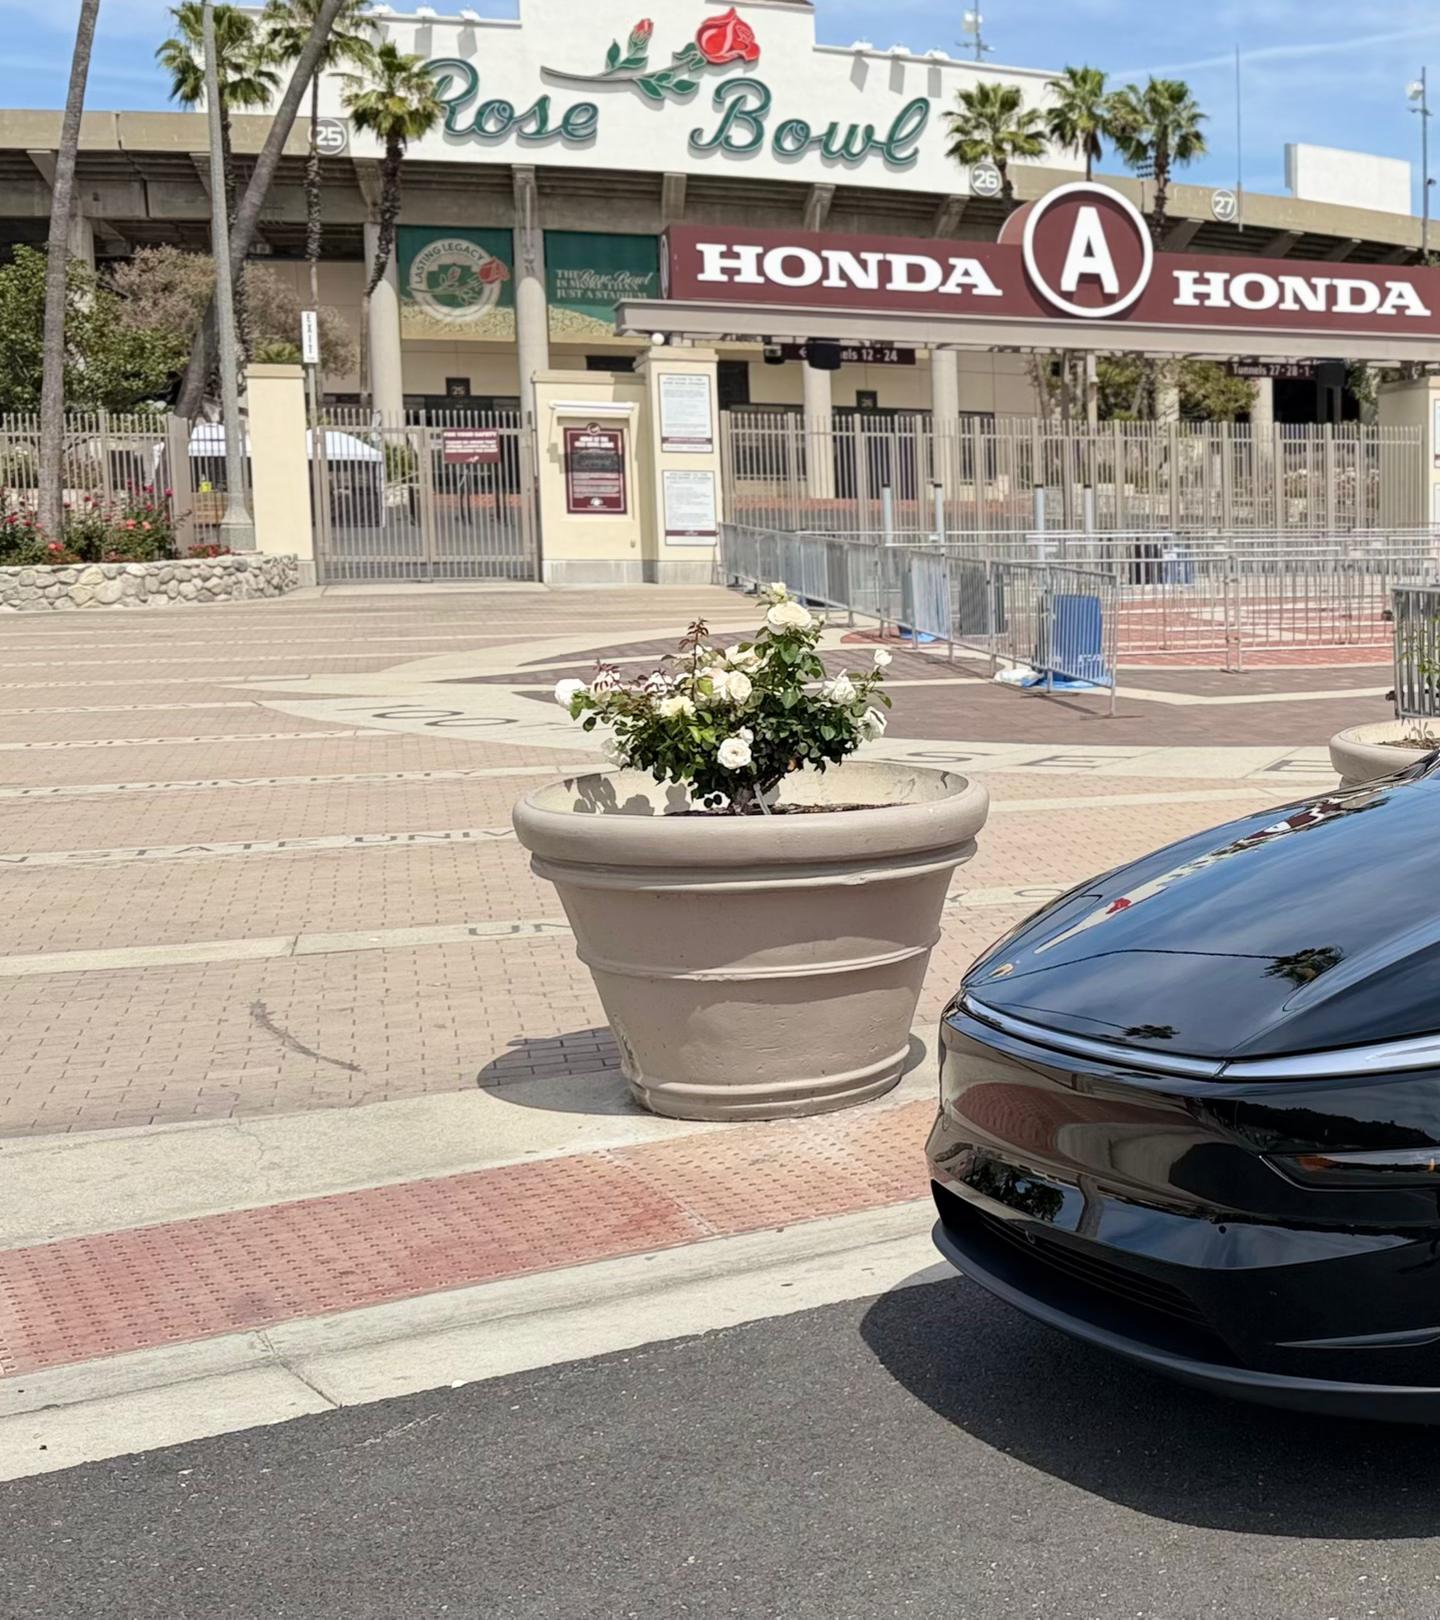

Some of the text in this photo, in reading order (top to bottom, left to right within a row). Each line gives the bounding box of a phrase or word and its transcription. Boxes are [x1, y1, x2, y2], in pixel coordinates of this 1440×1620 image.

[423, 58, 598, 141] Rose
[315, 126, 343, 146] 25
[689, 78, 931, 165] Bowl
[974, 169, 998, 188] 26
[1214, 196, 1234, 214] 27
[415, 242, 485, 284] LASTING LEGACY
[1060, 206, 1120, 295] A
[556, 270, 581, 279] THE
[696, 243, 1003, 297] HONDA
[556, 289, 585, 299] JUST
[1172, 270, 1432, 317] HONDA
[861, 348, 873, 361] 12
[884, 350, 898, 362] 24
